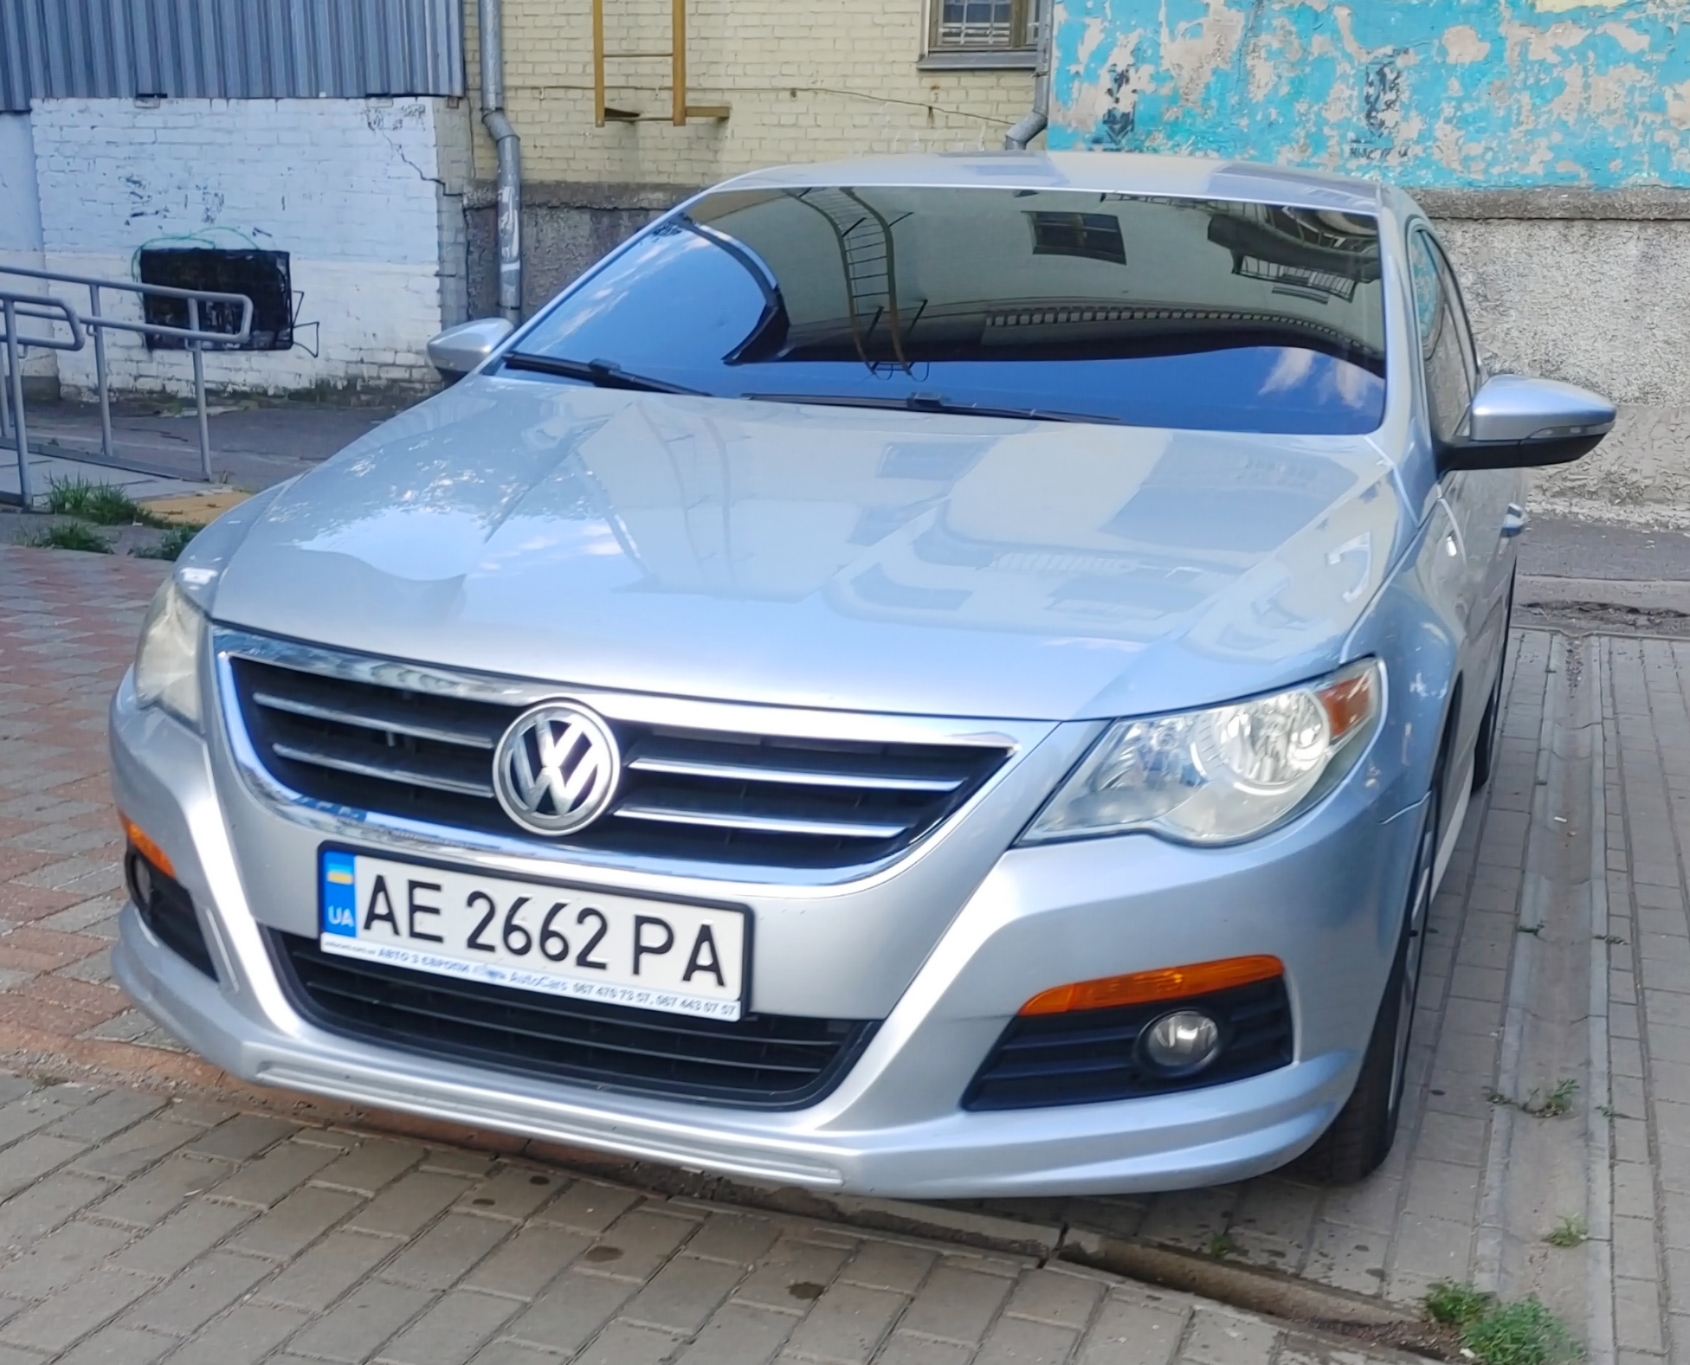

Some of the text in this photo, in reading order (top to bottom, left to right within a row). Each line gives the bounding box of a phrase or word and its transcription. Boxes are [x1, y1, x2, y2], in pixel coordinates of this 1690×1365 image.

[503, 704, 608, 824] VW
[327, 905, 355, 927] UA
[363, 874, 726, 988] AE 2662 PA
